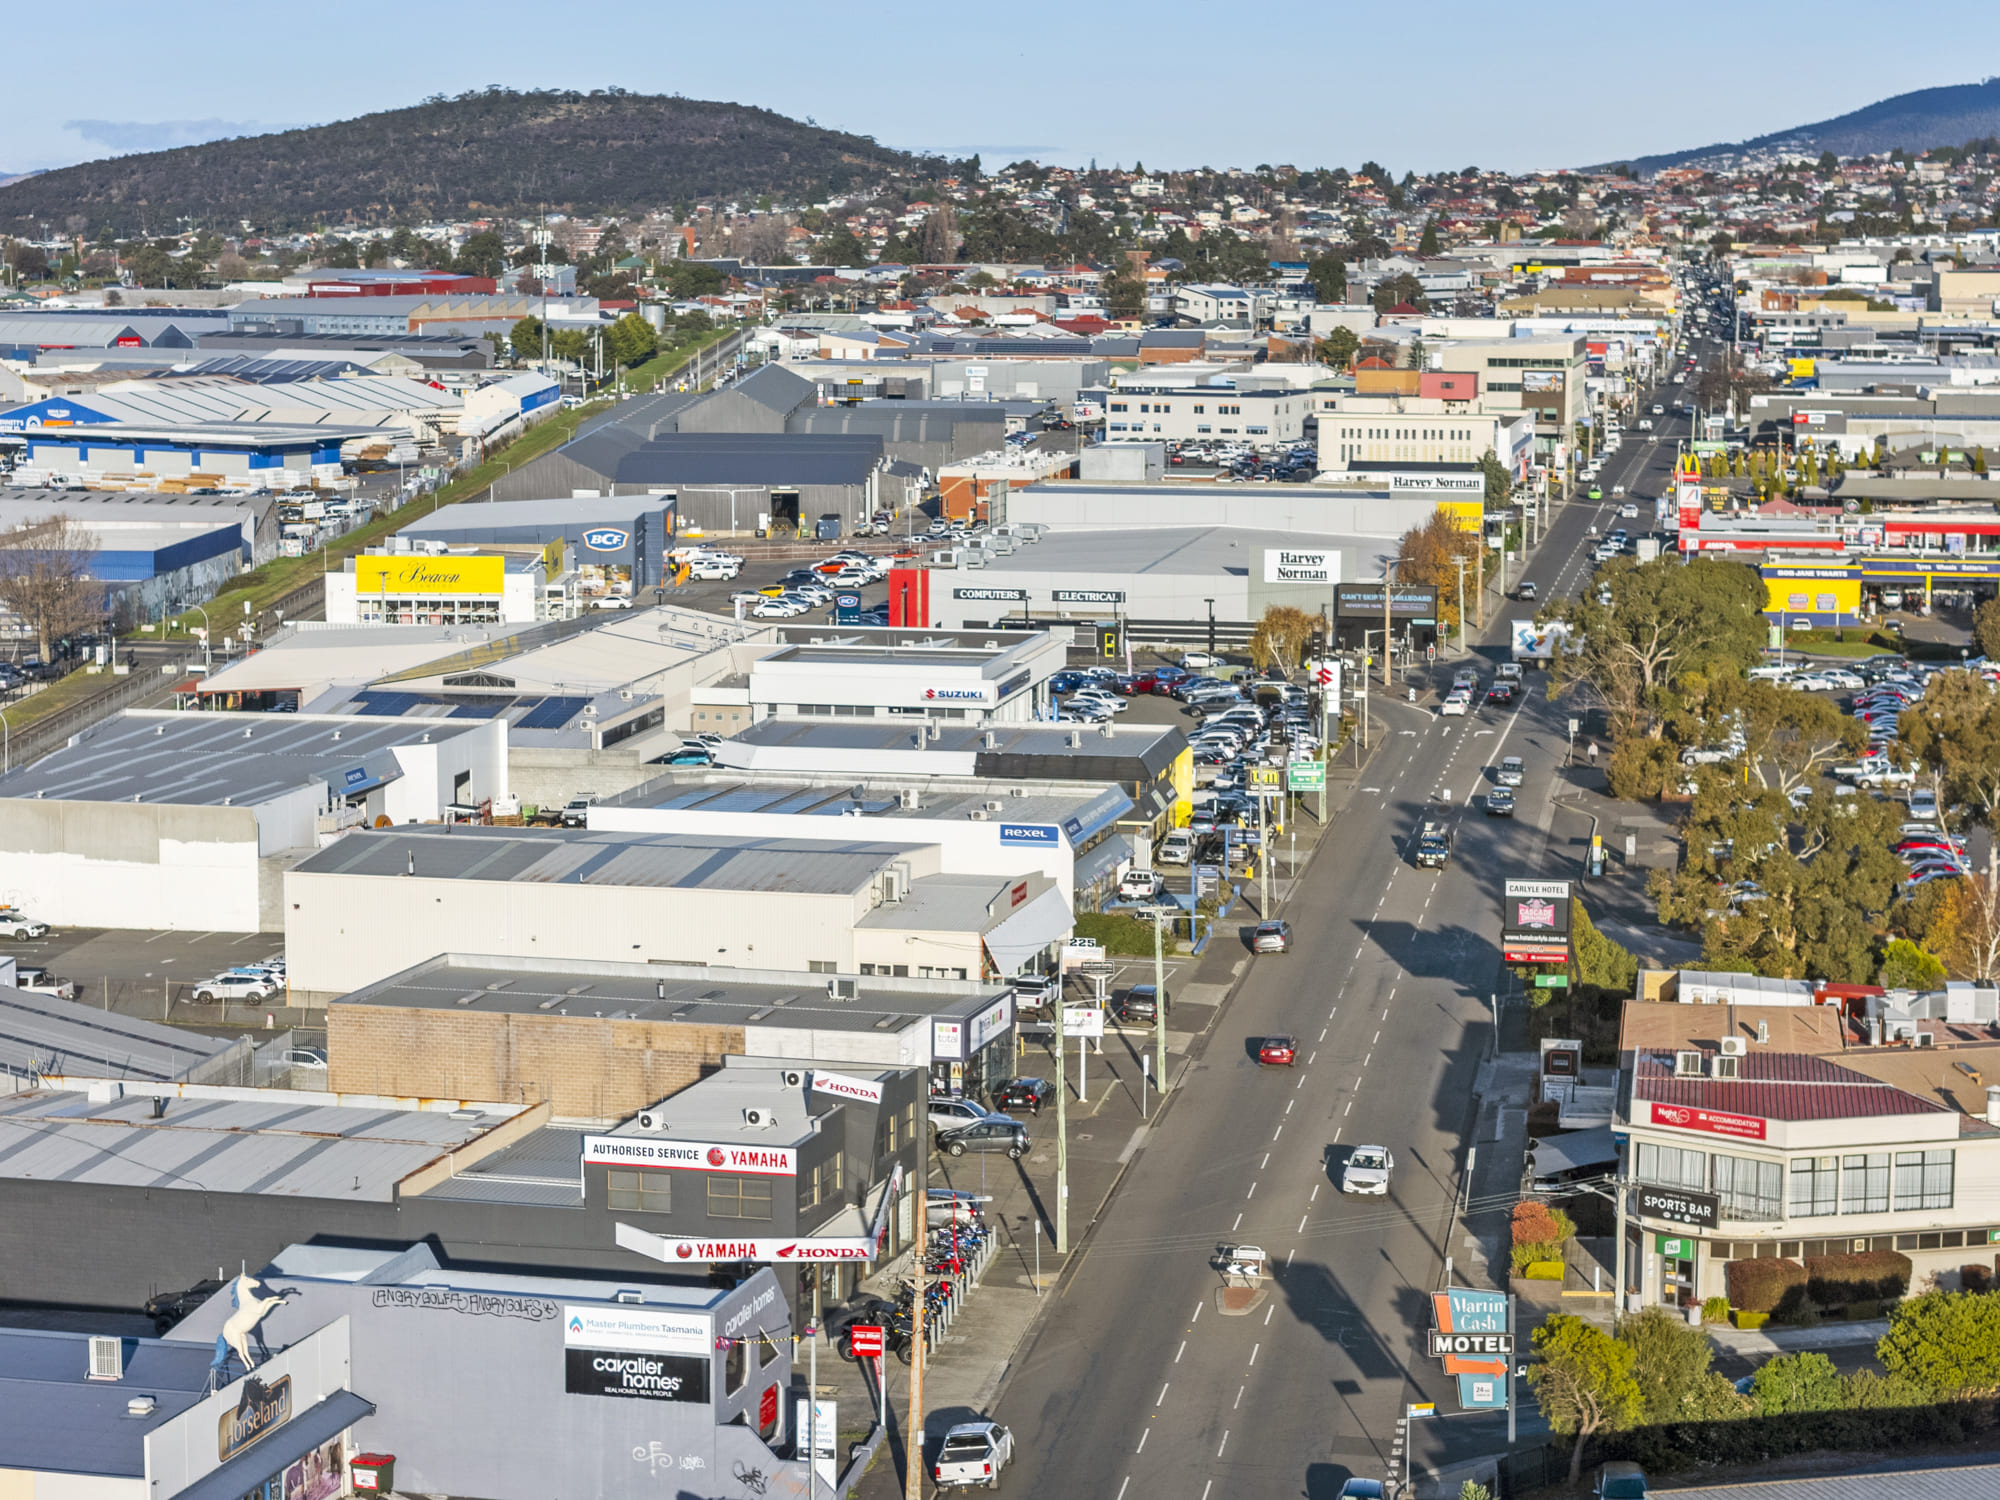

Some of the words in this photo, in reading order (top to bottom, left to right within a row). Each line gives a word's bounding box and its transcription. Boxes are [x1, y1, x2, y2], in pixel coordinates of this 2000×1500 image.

[1075, 407, 1092, 416] FedEx
[1394, 476, 1433, 490] Harvey
[1436, 477, 1480, 488] Norman
[590, 533, 622, 546] BCF
[1280, 551, 1324, 566] Harvey
[399, 560, 460, 584] Beacon
[1277, 567, 1328, 580] Norman
[1916, 564, 1932, 572] Tyres
[1936, 564, 1957, 572] Wheels
[1962, 564, 1988, 572] Batteries
[960, 590, 1020, 600] COMPUTERS
[1059, 592, 1118, 602] ELECTRICAL
[938, 690, 982, 699] SUZUKI
[1509, 884, 1540, 893] CARLYLE
[1542, 886, 1564, 894] HOTEL
[1070, 938, 1095, 947] 225
[830, 1083, 878, 1099] HONDA
[1658, 1108, 1677, 1118] Night
[1708, 1115, 1760, 1128] ACCOMMODATION
[593, 1144, 654, 1158] AUTHORISED
[658, 1148, 699, 1160] SERVICE
[730, 1150, 788, 1168] YAMAHA
[1644, 1196, 1687, 1212] SPORTS
[1689, 1204, 1712, 1217] BAR
[696, 1243, 757, 1258] YAMAHA
[797, 1248, 868, 1258] HONDA
[724, 1305, 752, 1336] cavalier
[752, 1288, 774, 1314] homes
[1452, 1297, 1504, 1314] Martin
[586, 1318, 616, 1328] Master
[618, 1321, 660, 1332] Plumbers
[662, 1324, 703, 1335] Tasmania
[1460, 1315, 1496, 1331] Cash
[1436, 1336, 1510, 1352] MOTEL
[593, 1358, 664, 1375] cavalier
[622, 1368, 680, 1390] homes
[226, 1386, 286, 1449] Horseland
